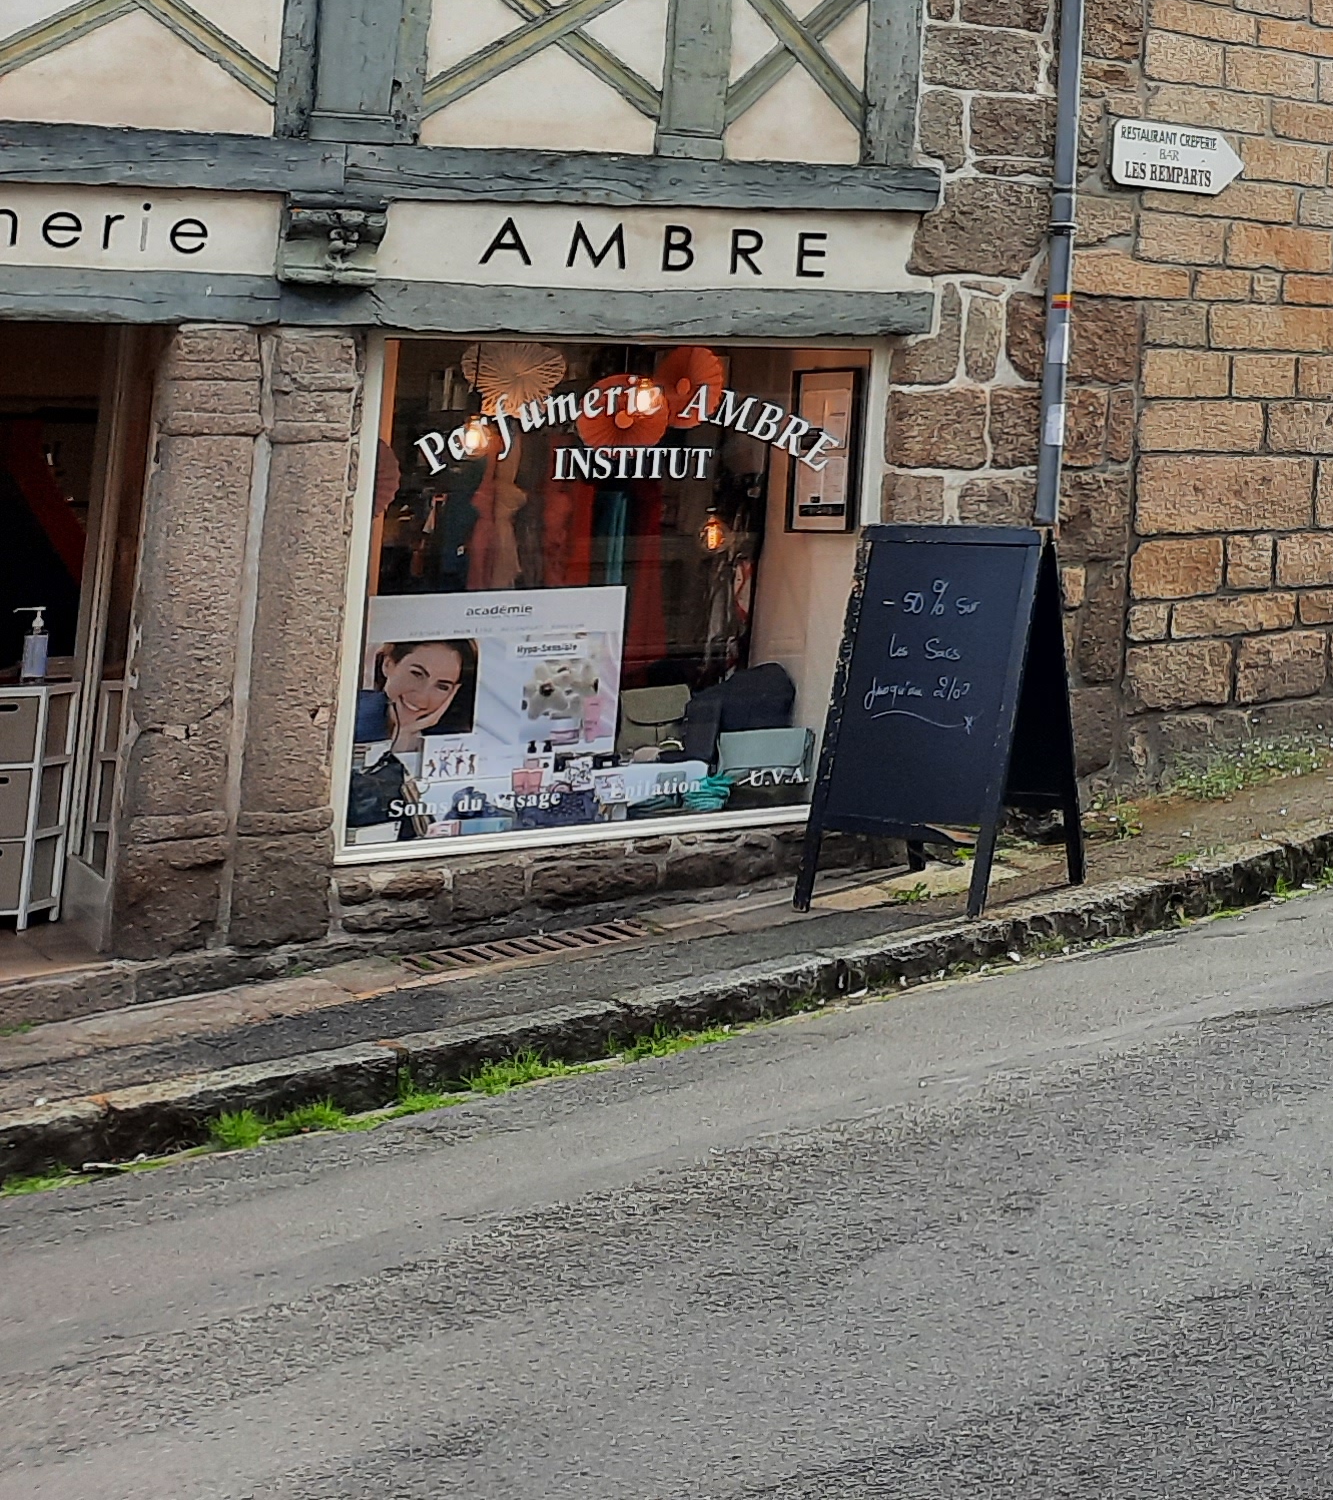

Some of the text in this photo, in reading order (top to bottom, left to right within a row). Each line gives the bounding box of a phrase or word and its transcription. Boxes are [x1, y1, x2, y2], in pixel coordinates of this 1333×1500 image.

[1121, 125, 1177, 146] RESTAURANT
[1159, 148, 1180, 161] BAR
[1124, 160, 1212, 187] LES REMPARTS
[478, 216, 828, 278] AMBRE
[413, 374, 841, 476] Parfumerie AMBRE
[551, 447, 713, 481] INSTITUT
[465, 603, 533, 617] académie
[388, 799, 449, 818] Soins
[458, 795, 482, 812] du
[750, 767, 810, 787] U.V.A.
